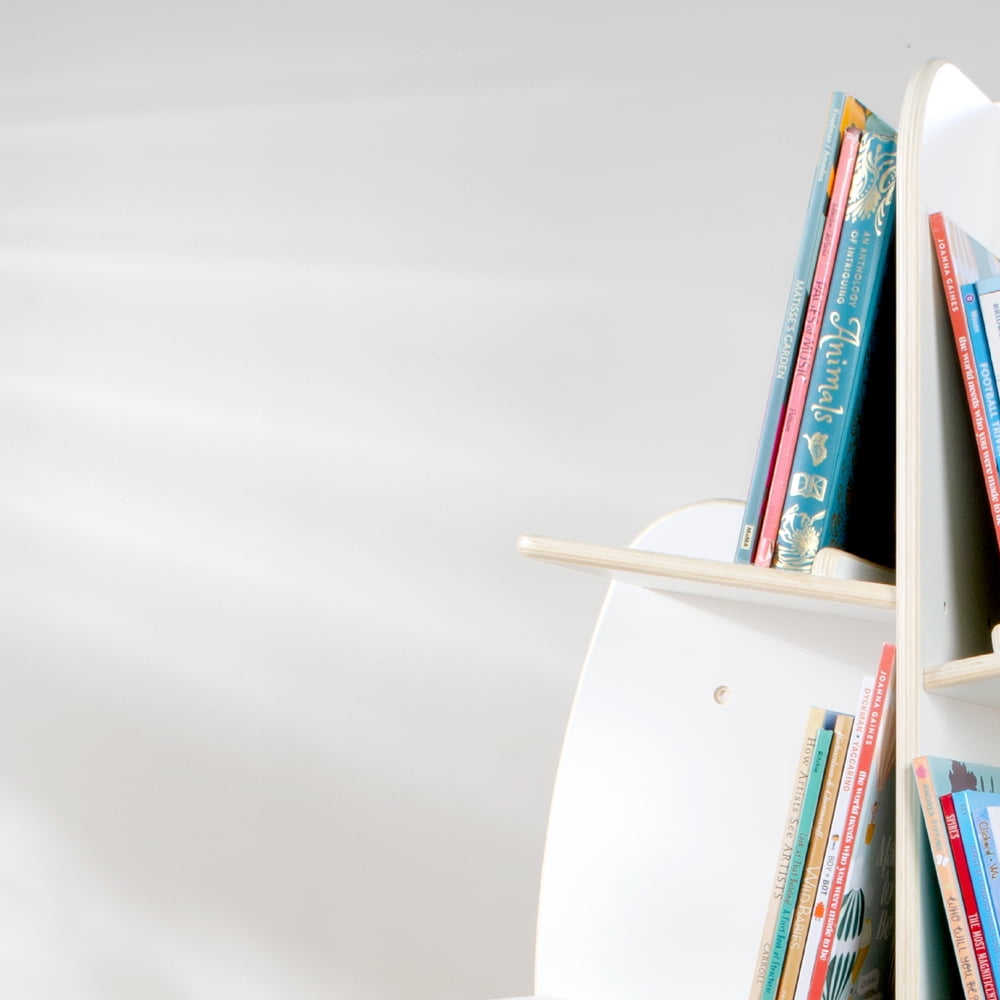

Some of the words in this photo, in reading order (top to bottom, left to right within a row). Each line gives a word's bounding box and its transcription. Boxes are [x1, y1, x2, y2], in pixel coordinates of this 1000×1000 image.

[850, 230, 858, 244] OF
[862, 230, 871, 244] AN
[837, 246, 856, 304] INTRIGUING
[849, 247, 868, 308] ANTHOLOGY
[938, 238, 951, 275] JOANNA
[946, 278, 958, 312] GAINES
[787, 279, 804, 331] MATISSE'S
[808, 280, 824, 324] PAGES
[805, 325, 813, 336] of
[958, 336, 967, 347] the
[777, 333, 793, 379] GARDEN
[797, 336, 813, 380] MUSIC
[810, 311, 860, 424] Animals
[961, 347, 974, 380] world
[967, 380, 980, 409] needs
[981, 362, 998, 418] FOOTBALL
[974, 409, 985, 430] who
[976, 432, 988, 450] you
[983, 450, 993, 474] were
[987, 475, 1000, 502] made
[873, 669, 886, 708] JOANNA
[857, 687, 870, 732] DYCKMAN
[866, 711, 878, 745] GAINES
[802, 736, 815, 766] How
[814, 750, 823, 773] Ritchie
[844, 740, 859, 792] YACCARINO
[857, 770, 866, 786] the
[792, 770, 808, 813] Artists
[851, 786, 862, 814] world
[786, 817, 798, 838] See
[845, 815, 856, 843] needs
[946, 813, 959, 839] SPIRES
[797, 833, 807, 849] Look
[980, 820, 995, 855] Clickard
[989, 863, 1000, 879] Wu
[826, 855, 834, 871] BOY
[841, 844, 850, 865] who
[774, 842, 793, 900] ARTISTS
[791, 860, 802, 876] That
[834, 866, 845, 884] you
[821, 879, 829, 895] BOT
[831, 885, 841, 909] were
[948, 895, 961, 922] WHO
[968, 912, 979, 927] THE
[779, 915, 790, 933] First
[791, 904, 811, 951] BABIES
[825, 910, 836, 937] made
[776, 934, 786, 949] Book
[823, 938, 831, 948] to
[955, 925, 968, 951] WILL
[972, 930, 985, 951] MOST
[757, 942, 771, 985] CARROLL
[774, 951, 782, 960] of
[820, 948, 829, 961] be
[960, 955, 973, 977] YOU
